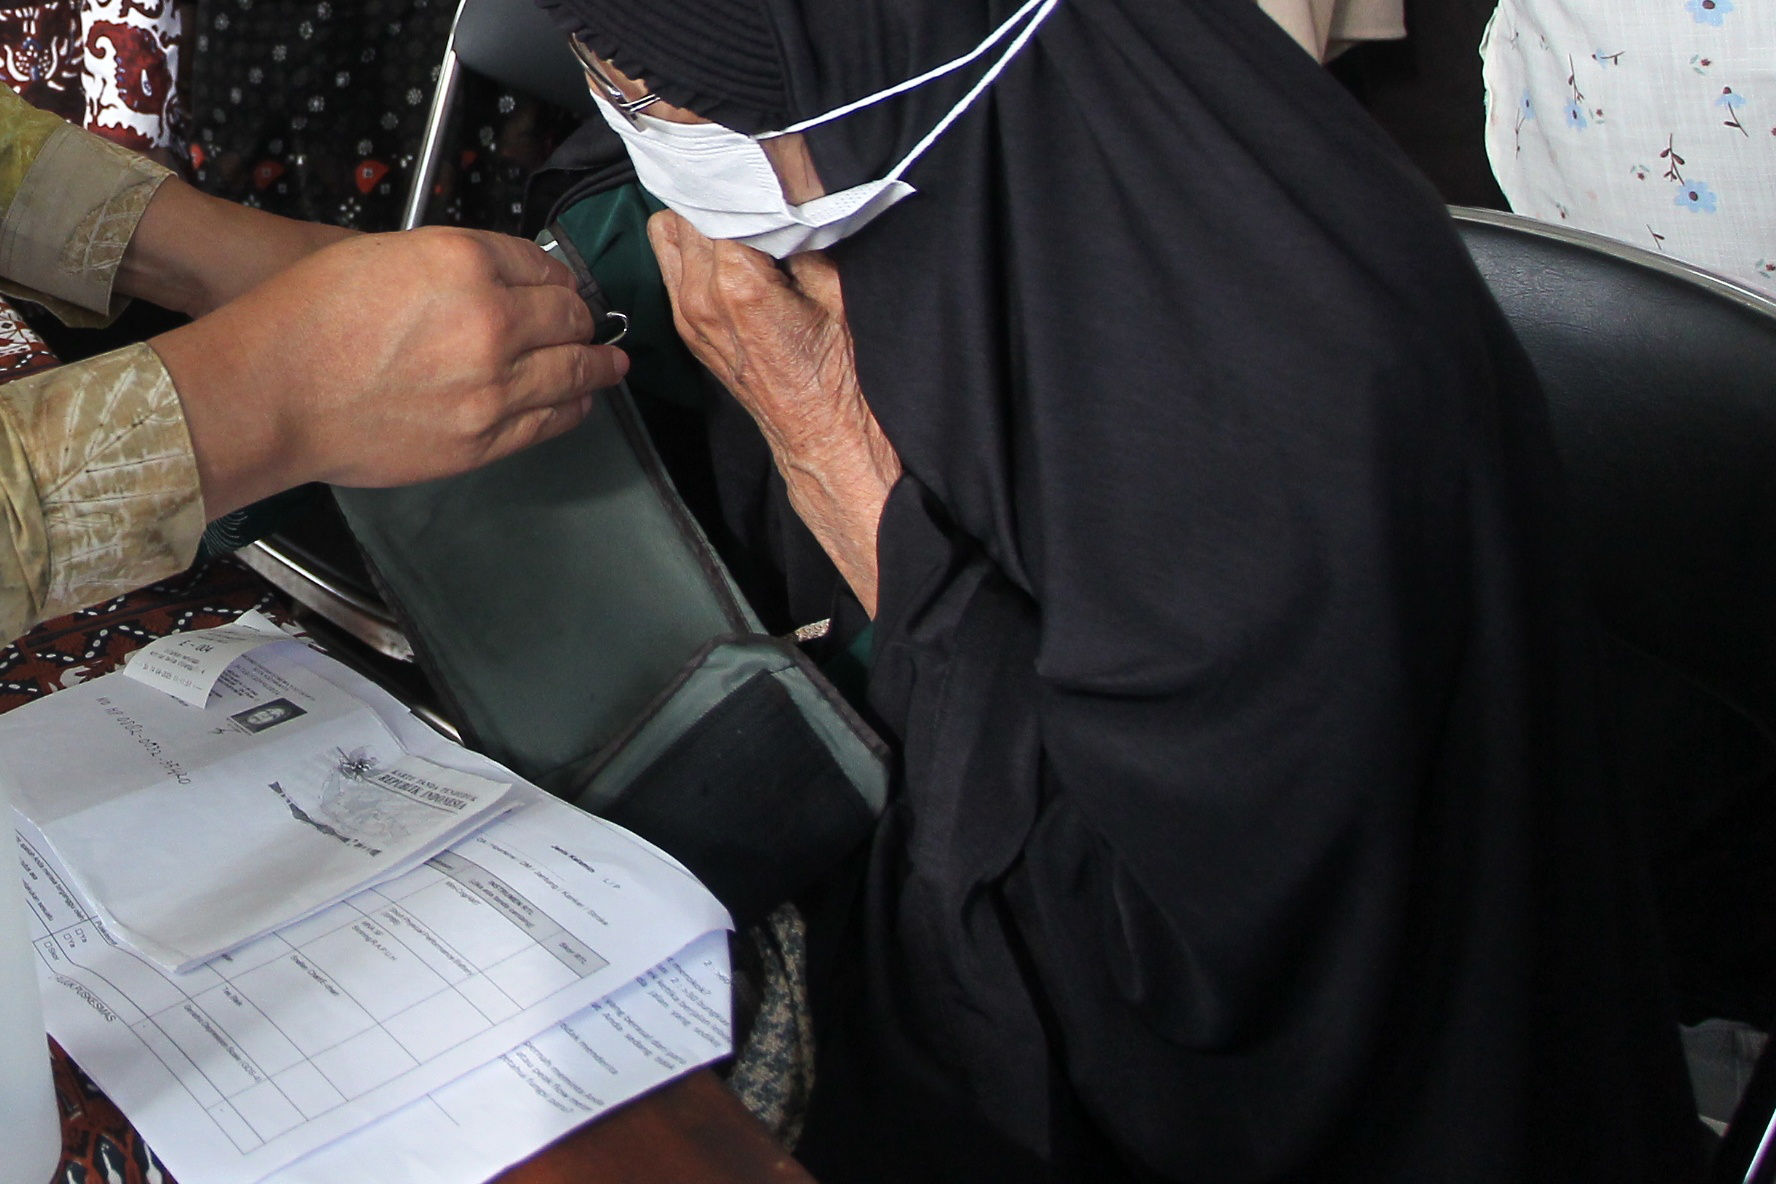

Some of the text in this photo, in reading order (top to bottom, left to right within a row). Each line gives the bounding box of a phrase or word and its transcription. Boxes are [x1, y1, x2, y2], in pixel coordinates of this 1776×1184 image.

[378, 773, 467, 810] REPUBLIK INDONESIA
[74, 984, 117, 1023] PUSKESMAS
